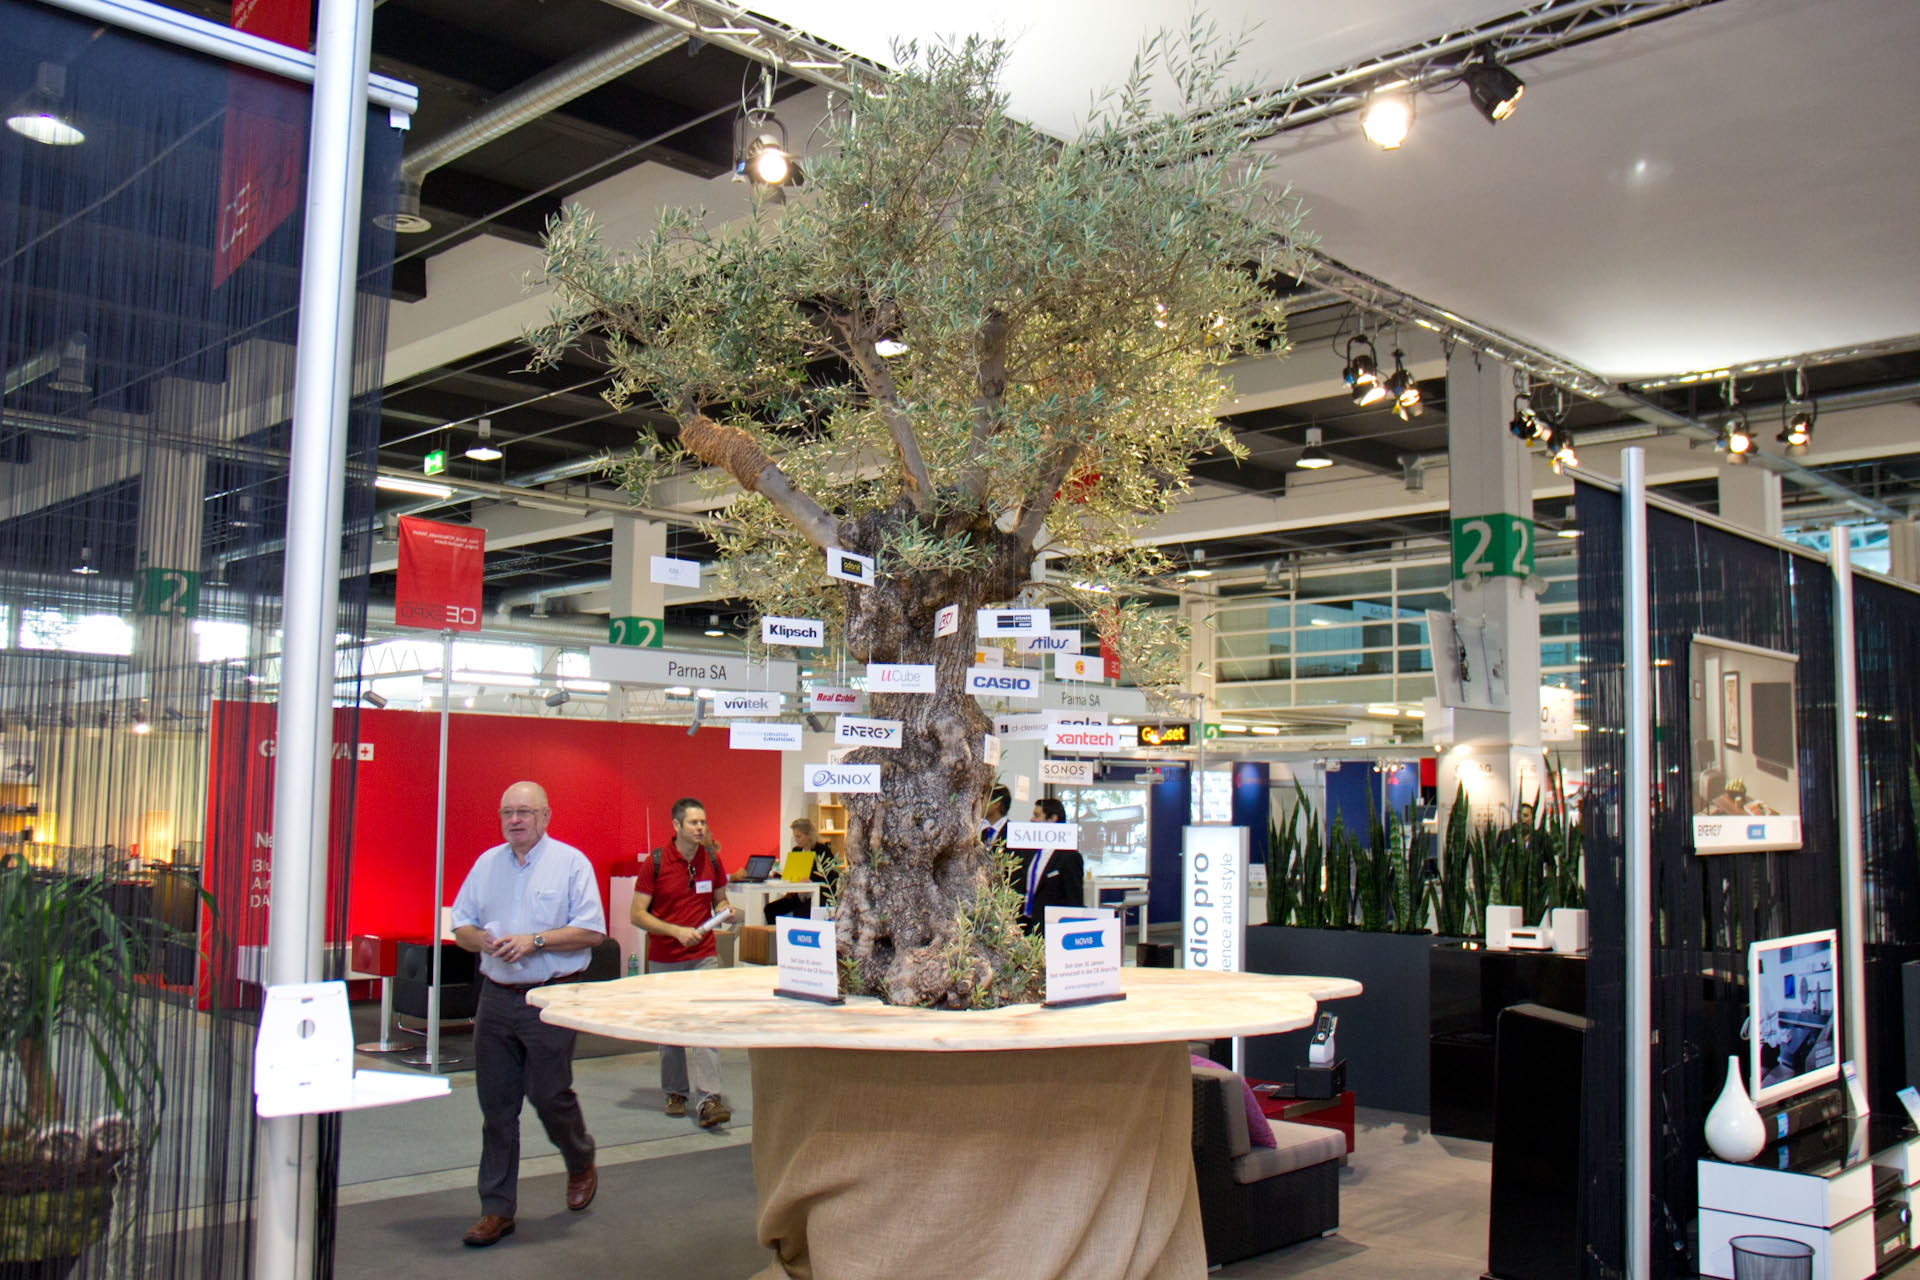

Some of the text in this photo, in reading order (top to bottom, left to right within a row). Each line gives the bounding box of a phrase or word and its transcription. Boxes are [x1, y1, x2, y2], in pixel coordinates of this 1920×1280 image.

[1462, 521, 1494, 574] 2
[1512, 520, 1530, 574] 2
[770, 624, 817, 639] Klipsch
[668, 661, 727, 681] Parna SA
[973, 676, 1031, 691] CASIO
[724, 696, 769, 710] vivitek
[1055, 731, 1114, 746] xantech
[1043, 764, 1086, 776] SONOS
[1014, 830, 1067, 843] SAILOR
[1193, 852, 1214, 908] pro
[1219, 852, 1236, 891] style
[1219, 895, 1232, 925] and
